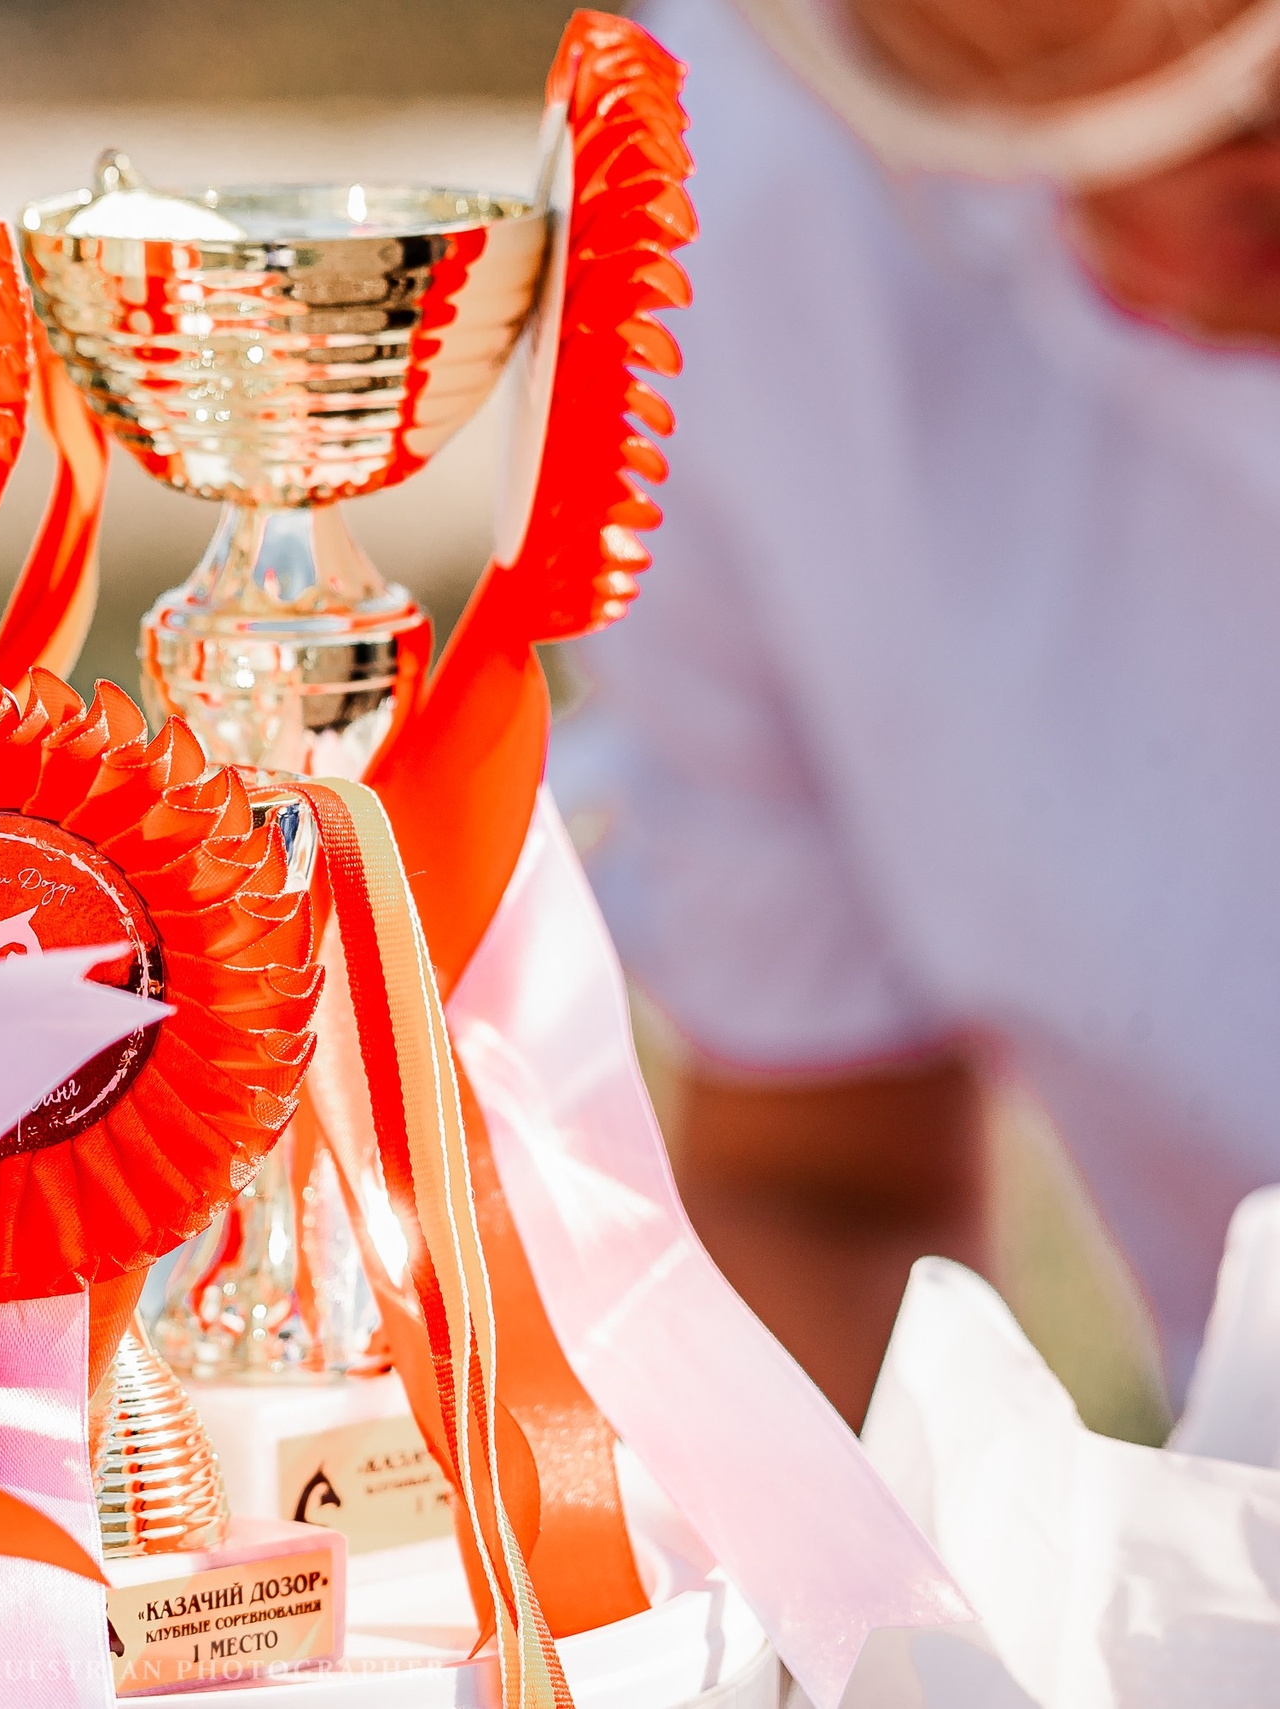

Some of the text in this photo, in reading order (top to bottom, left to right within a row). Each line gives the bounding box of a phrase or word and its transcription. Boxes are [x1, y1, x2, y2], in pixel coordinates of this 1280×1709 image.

[18, 867, 76, 906] Дозор
[138, 1571, 329, 1622] «КАЗАЧИЙ ДОЗОР»
[145, 1599, 322, 1643] КЛУБНЫЕ СОРЕВНОВАНИЯ
[193, 1630, 279, 1663] 1 МЕСТО
